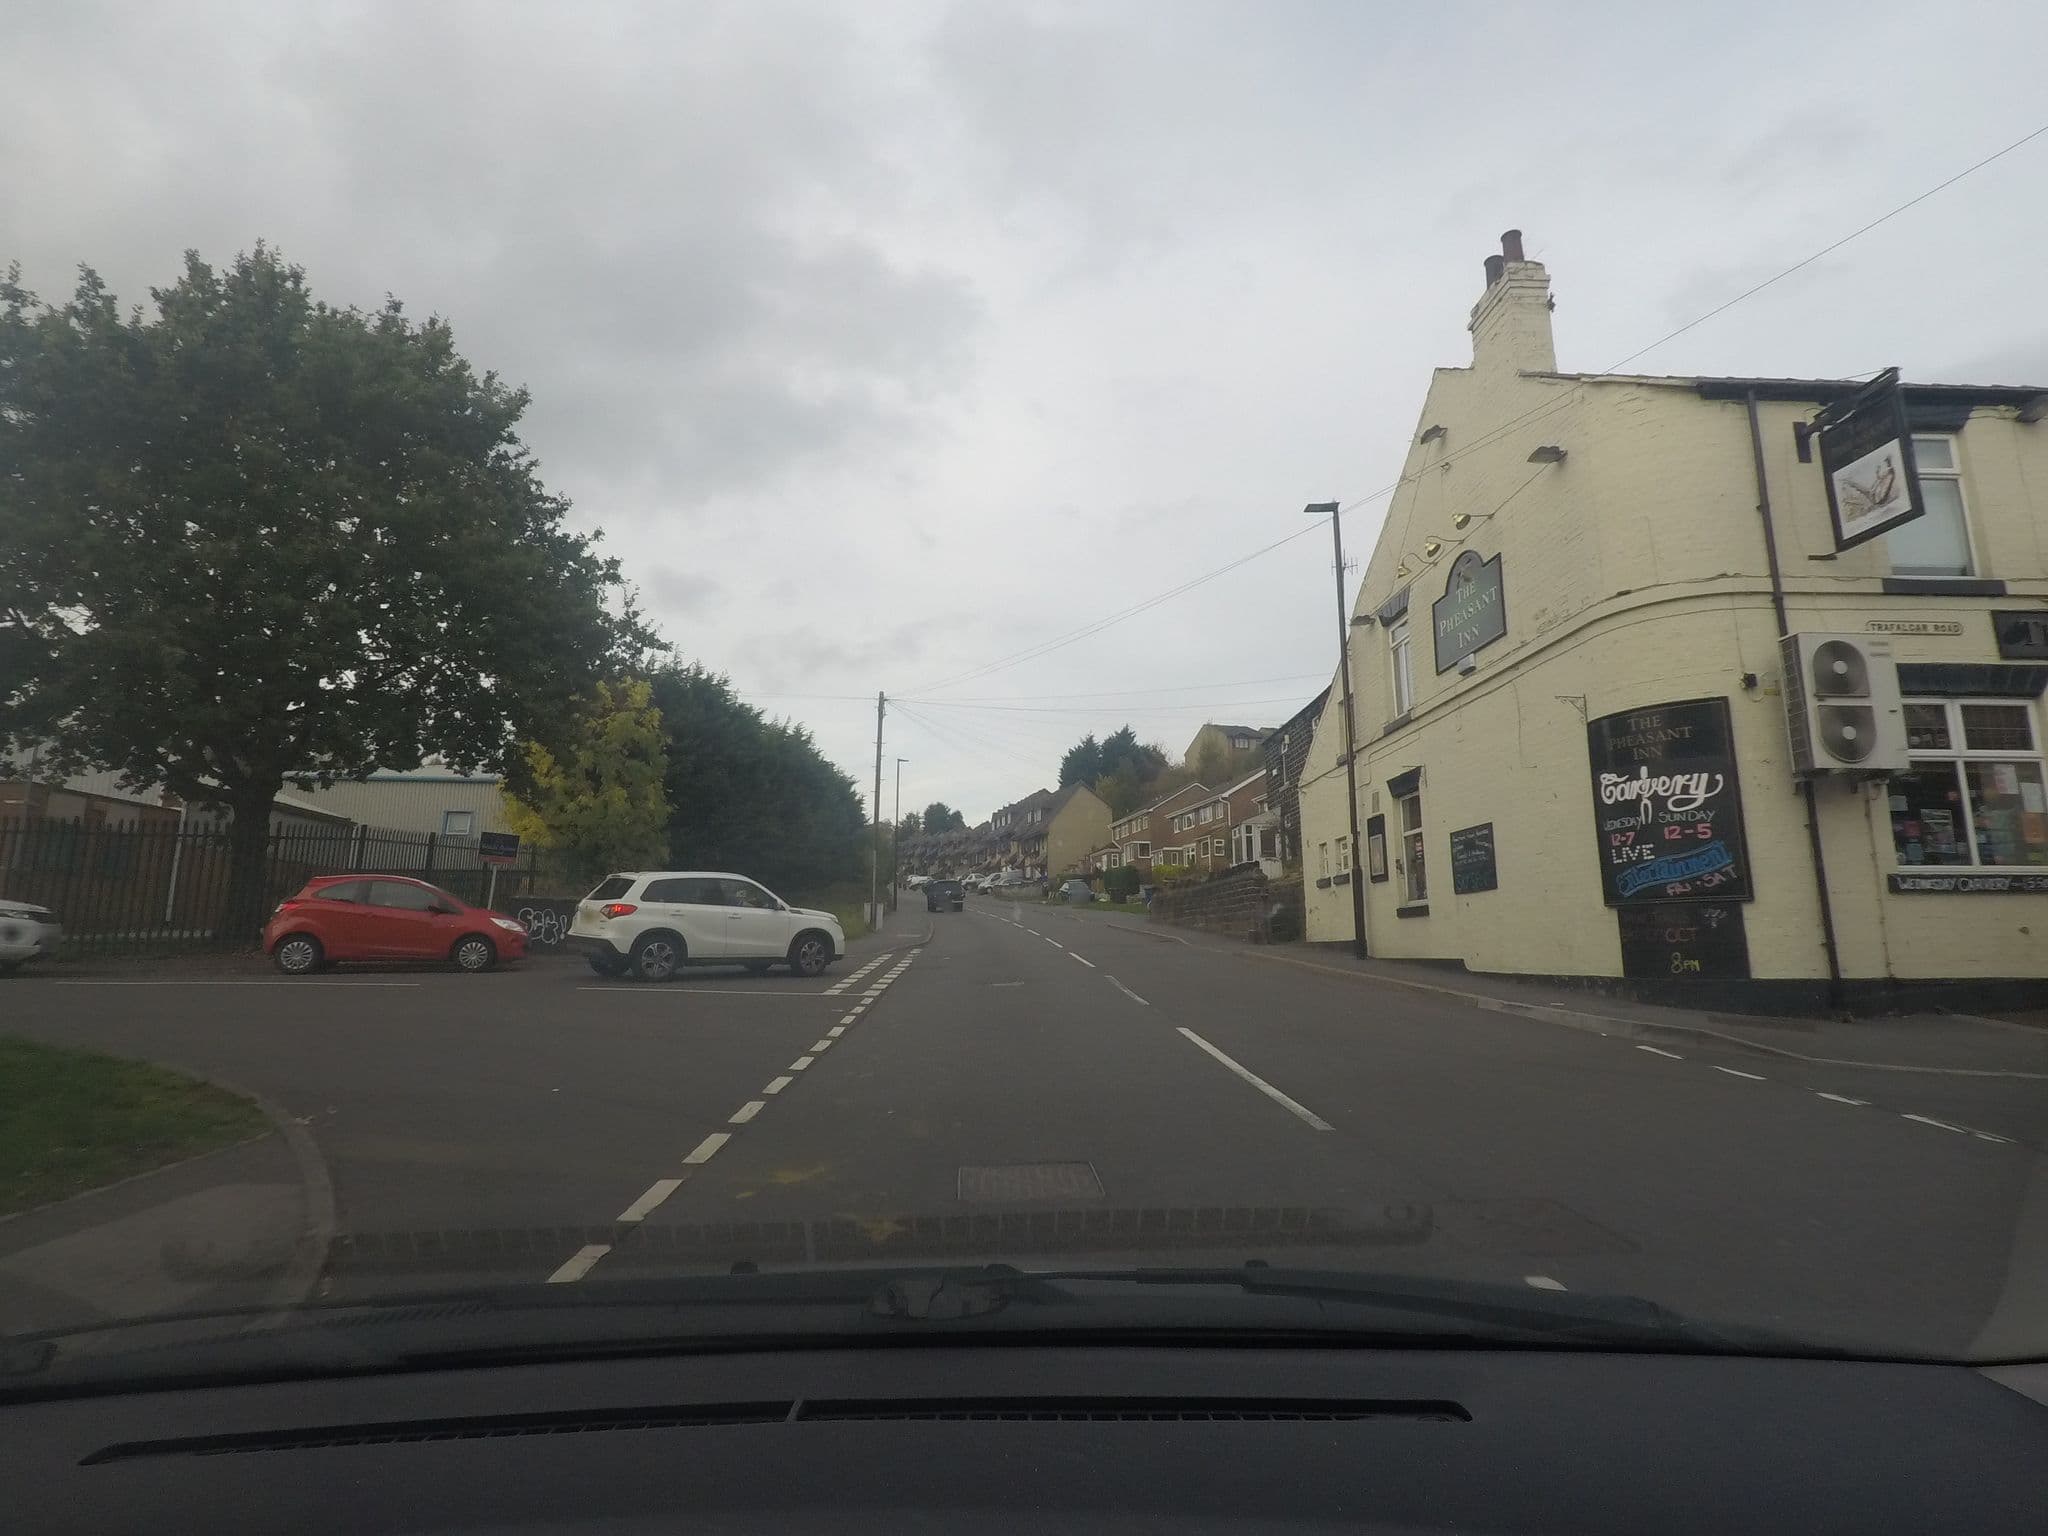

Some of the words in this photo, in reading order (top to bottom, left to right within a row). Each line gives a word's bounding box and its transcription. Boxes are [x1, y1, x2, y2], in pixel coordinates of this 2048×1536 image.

[1455, 582, 1477, 604] THE
[1439, 585, 1498, 638] PHEASANT
[1458, 623, 1480, 649] INN
[1869, 622, 1929, 633] TRAFALGAR
[1932, 623, 1962, 634] ROAD
[1626, 714, 1663, 732] THE
[1607, 725, 1694, 752] PHEASANT
[1632, 745, 1663, 761] INN
[1658, 809, 1717, 824] SUNDAY
[1611, 843, 1656, 865] LIVE
[1702, 864, 1738, 889] SAT
